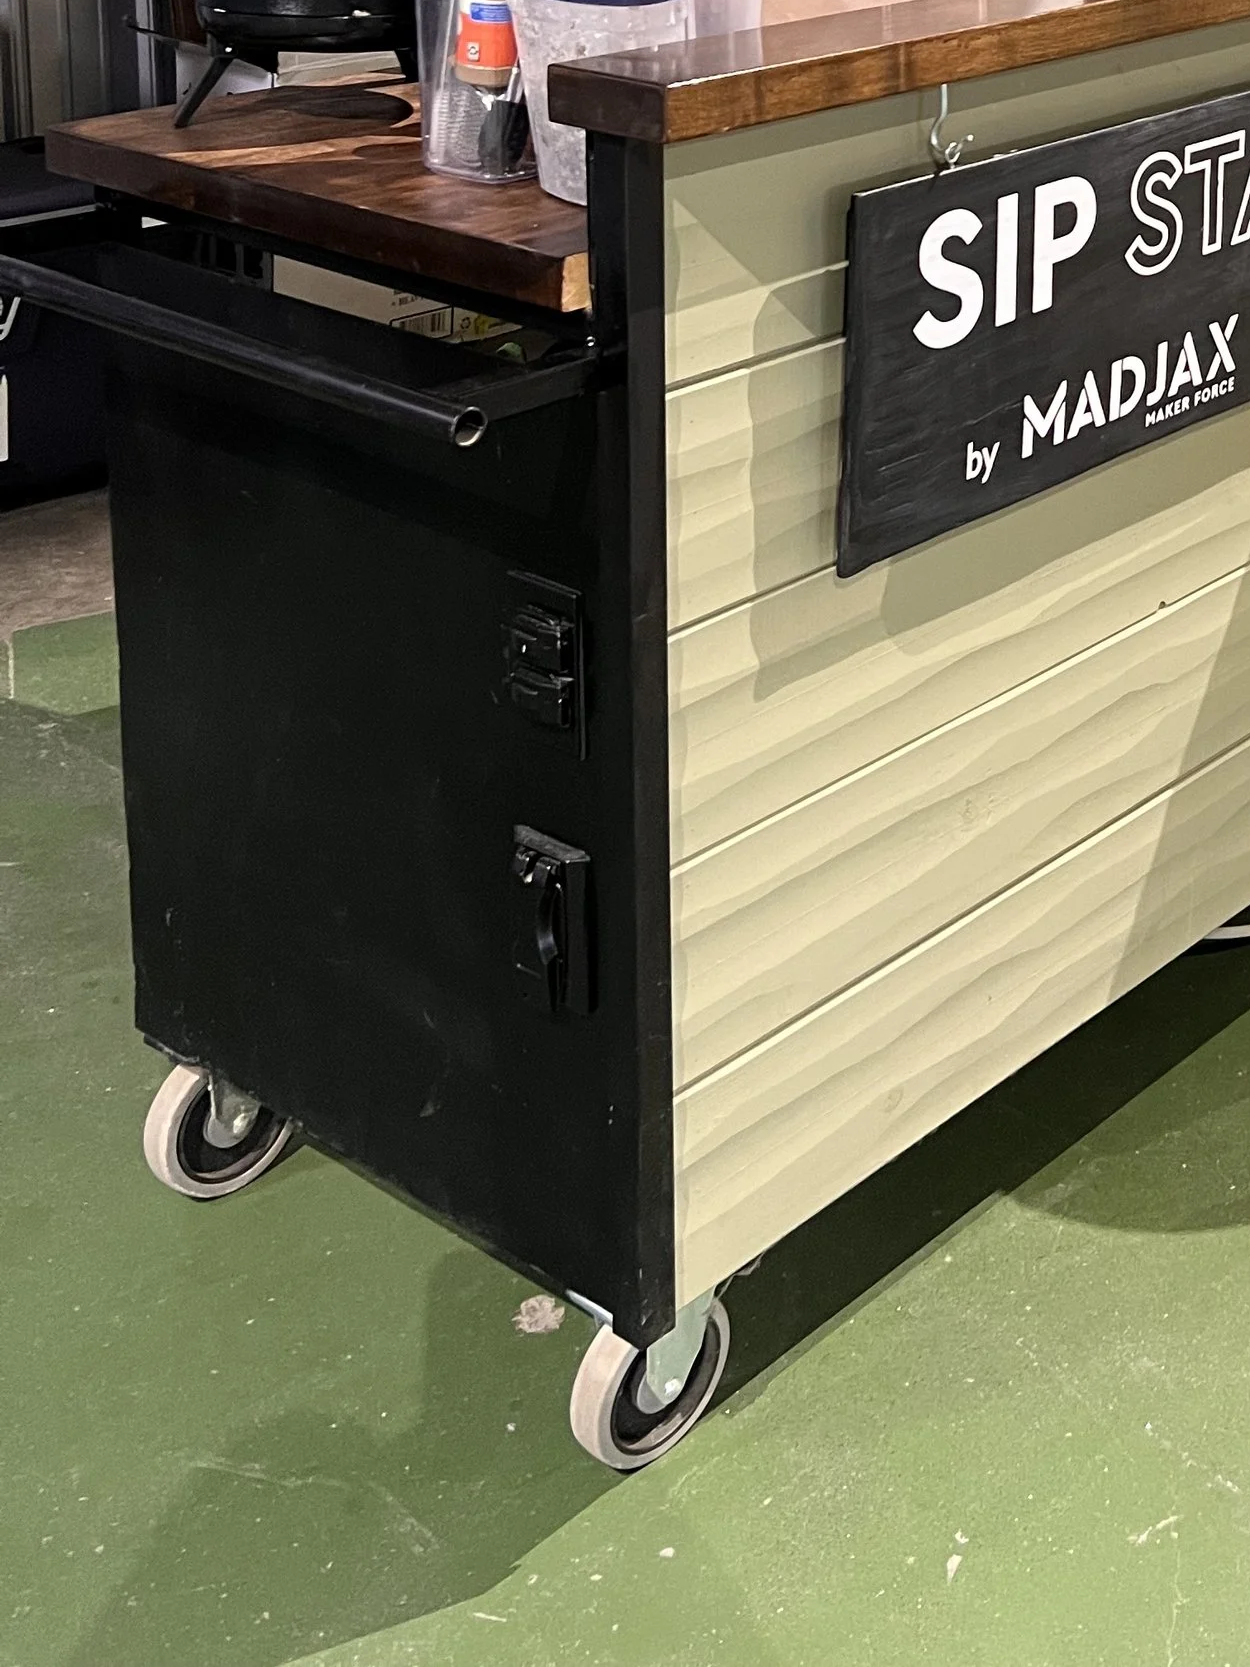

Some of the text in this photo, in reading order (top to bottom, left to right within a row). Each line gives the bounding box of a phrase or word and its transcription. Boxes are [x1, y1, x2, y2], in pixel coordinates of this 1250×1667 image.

[912, 176, 1098, 349] SIP
[965, 313, 1239, 484] by MADJAX
[1144, 376, 1236, 428] MAKER FORCE
